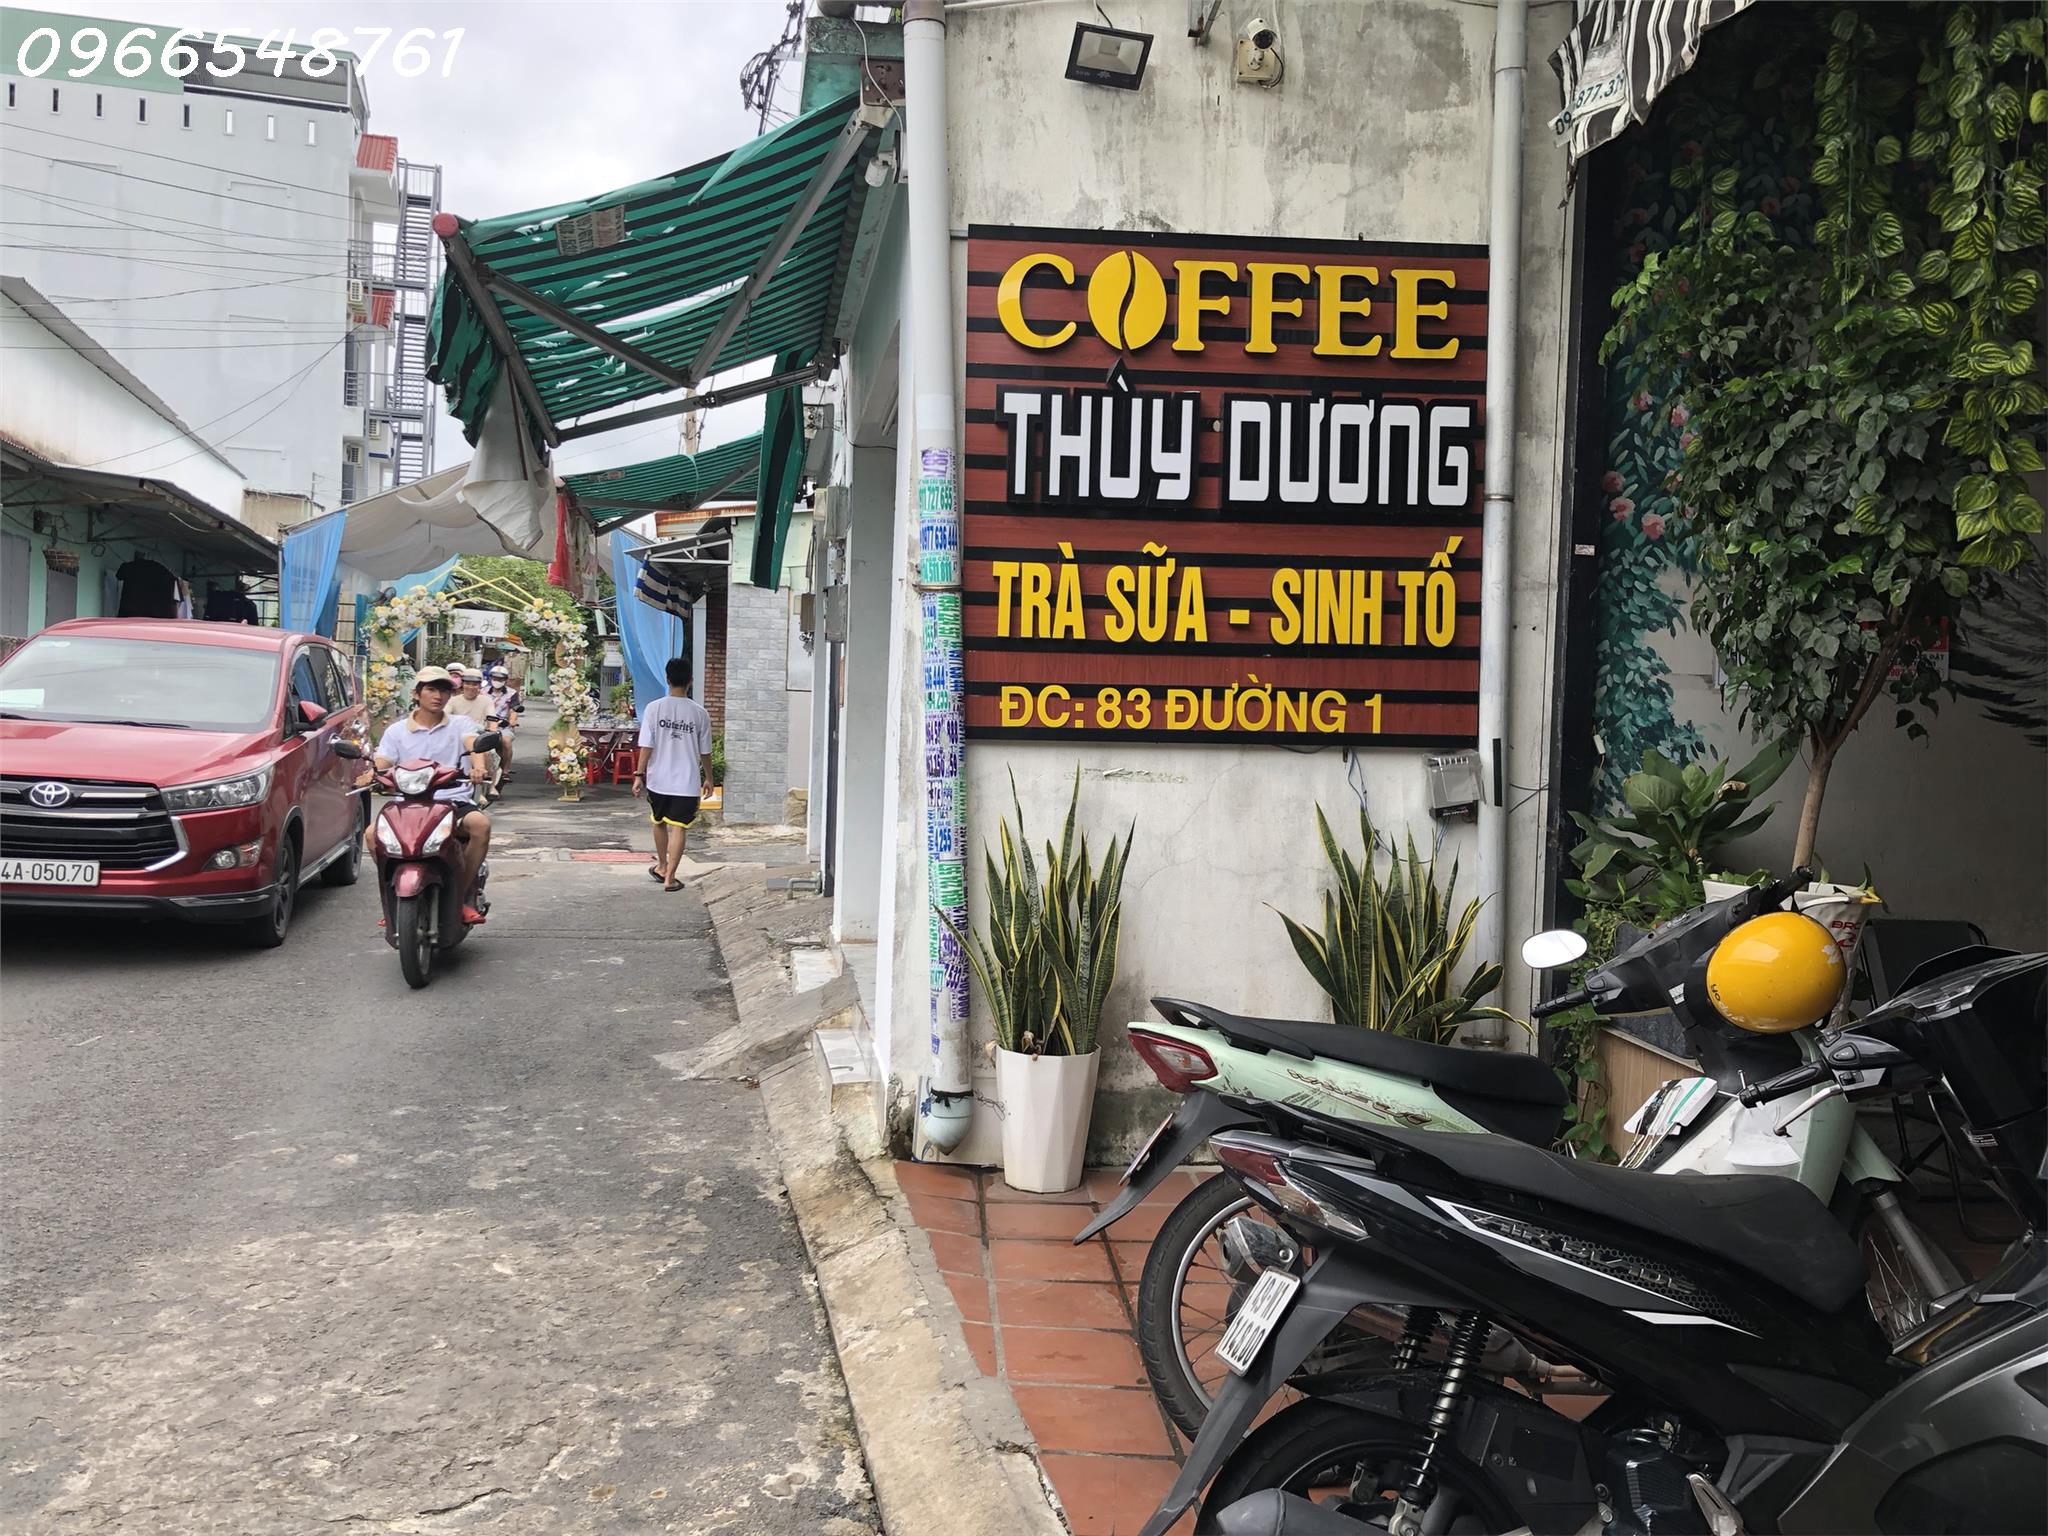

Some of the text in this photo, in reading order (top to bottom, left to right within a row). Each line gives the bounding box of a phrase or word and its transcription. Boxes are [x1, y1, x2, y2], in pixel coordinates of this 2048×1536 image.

[997, 250, 1460, 359] COFFEE
[1003, 373, 1471, 507] THÙY DƯƠNG
[992, 536, 1464, 648] TRÀ SỮA - SINH TỐ
[999, 685, 1085, 730] ĐC:
[1096, 687, 1152, 731] 83
[1165, 674, 1347, 734] ĐƯỜNG
[1363, 693, 1383, 735] 1
